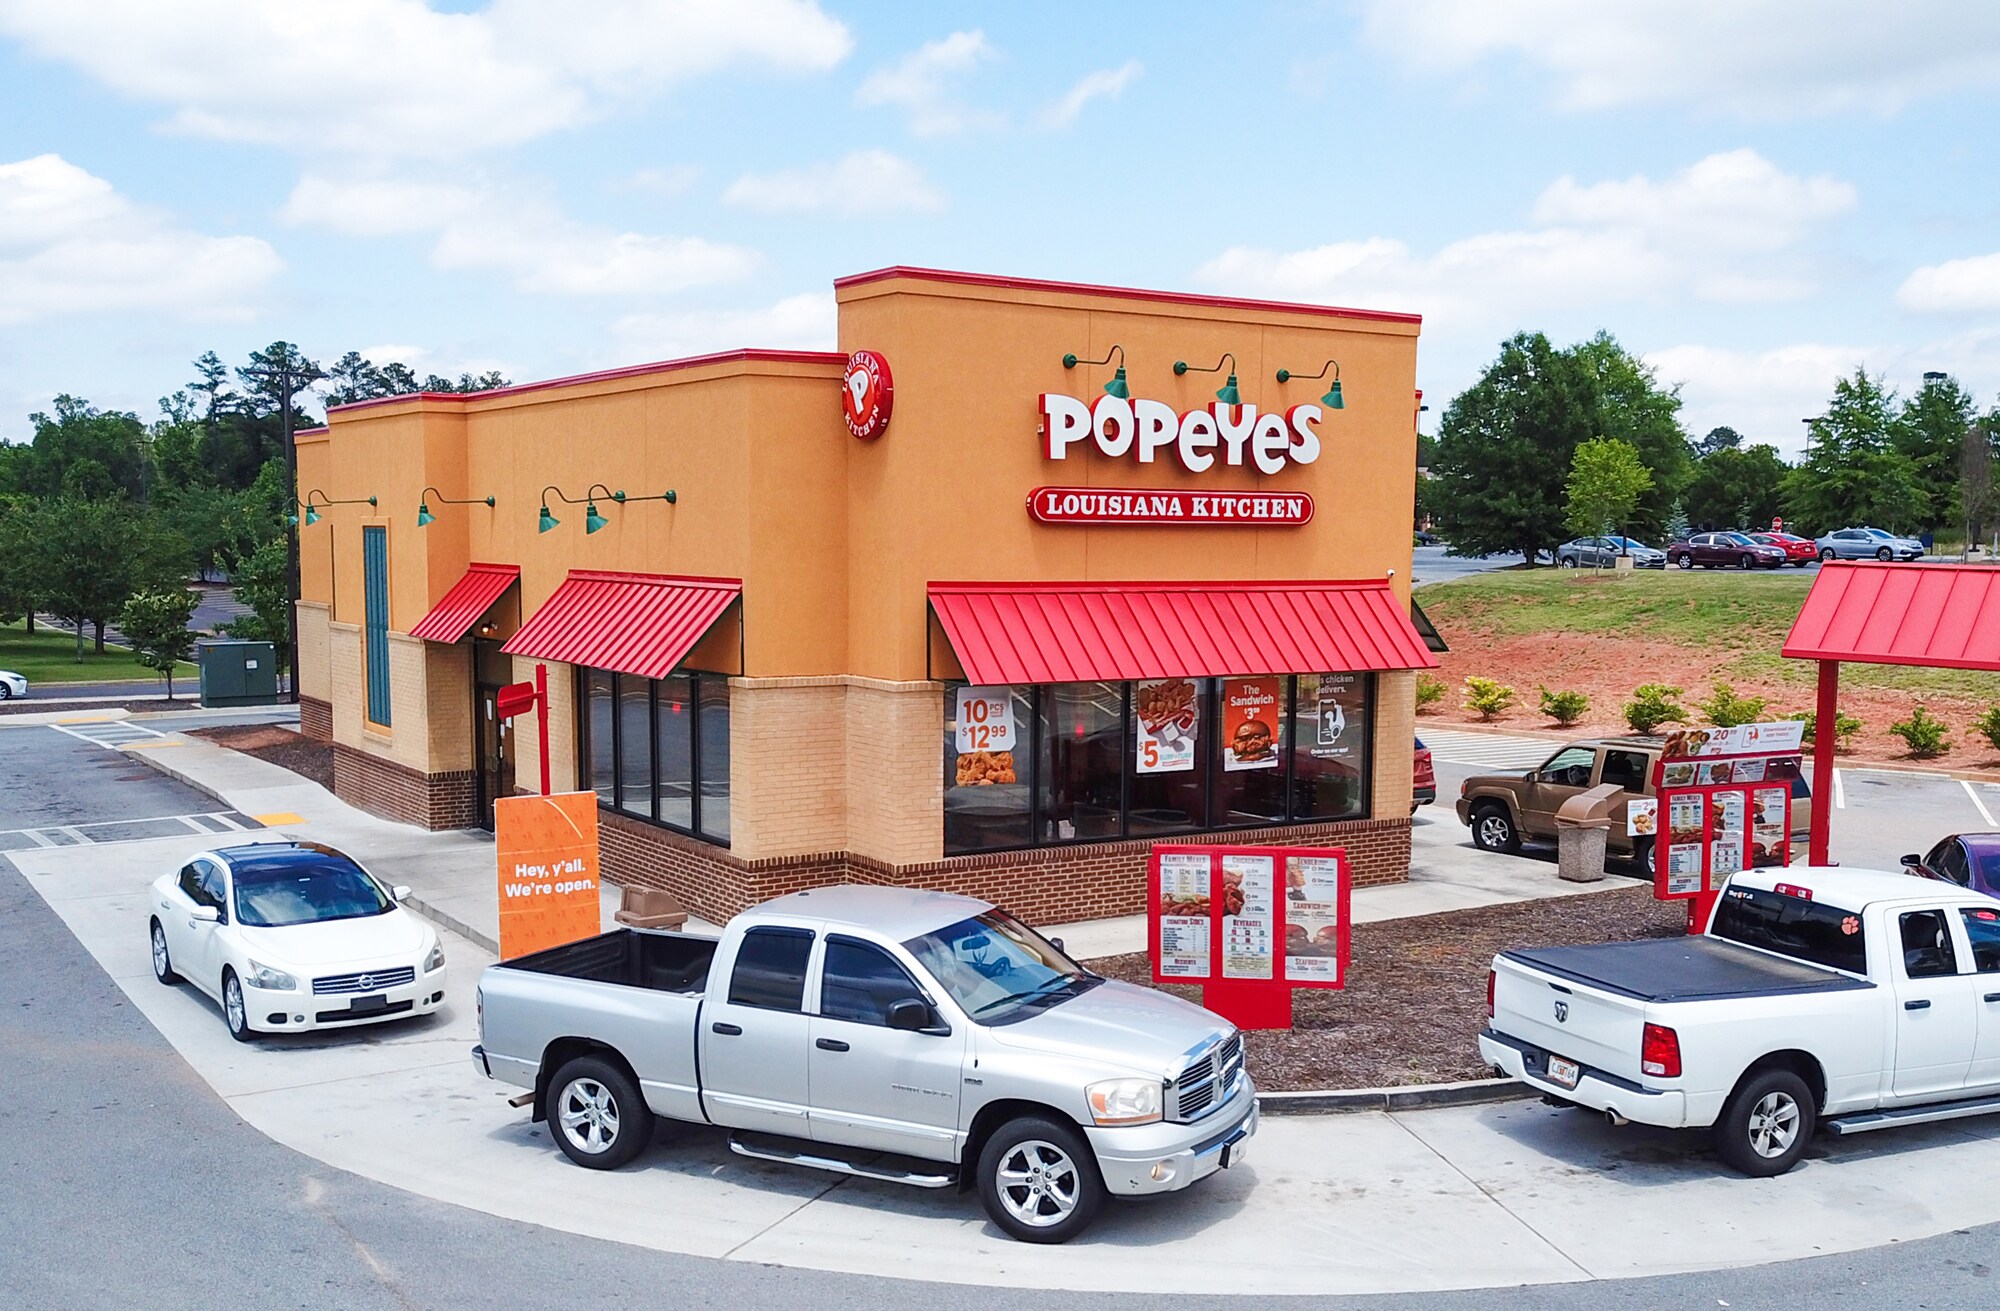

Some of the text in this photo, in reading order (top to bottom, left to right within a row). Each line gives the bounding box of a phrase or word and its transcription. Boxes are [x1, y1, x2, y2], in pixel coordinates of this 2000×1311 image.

[842, 352, 879, 393] LOUISIANA
[849, 370, 869, 415] P
[845, 403, 879, 437] KITCHEN
[1046, 493, 1303, 519] LOUISIANA KITCHEN
[1325, 675, 1354, 684] chicken
[1243, 685, 1260, 695] The
[1316, 685, 1347, 694] delivers.
[1230, 694, 1274, 707] Sandwich
[963, 699, 988, 723] 10
[515, 863, 550, 878] Hey,
[554, 879, 596, 895] open.
[1233, 919, 1262, 927] BEVERAGES
